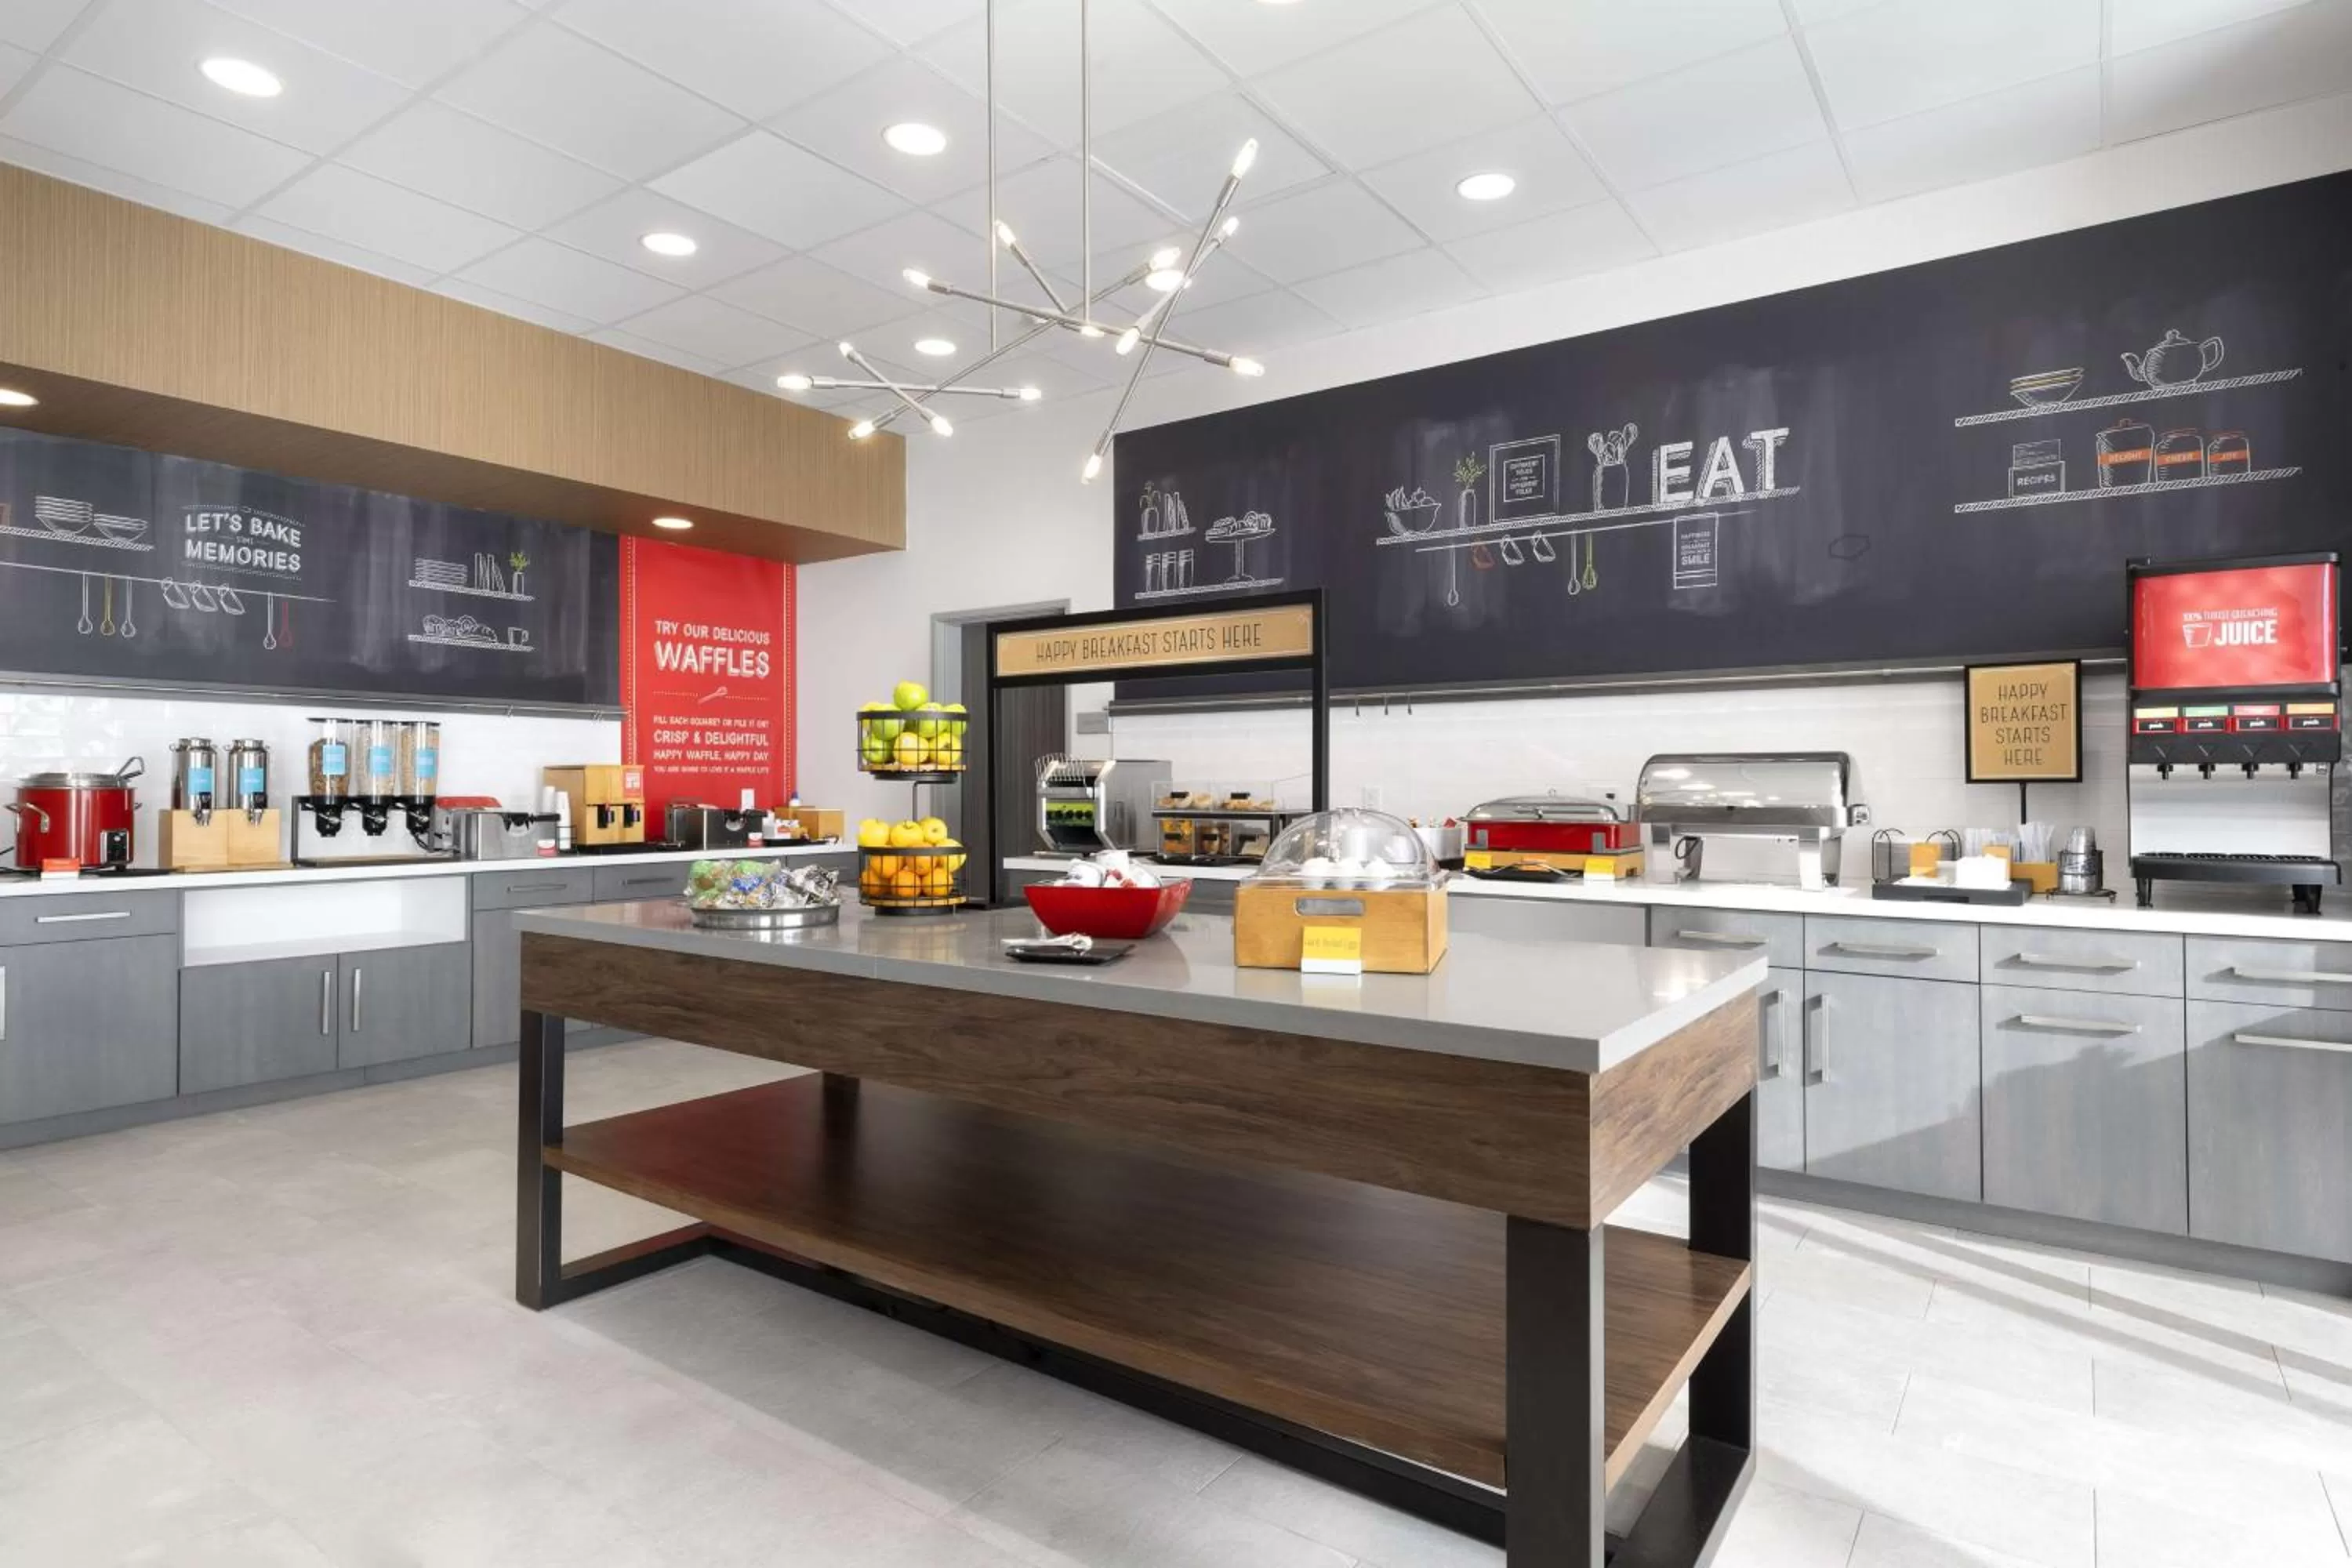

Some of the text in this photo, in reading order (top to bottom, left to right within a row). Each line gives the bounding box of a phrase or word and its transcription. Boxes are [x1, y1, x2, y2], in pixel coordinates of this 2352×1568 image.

[1652, 427, 1790, 506] EAT
[2108, 451, 2143, 463] DELIGHT
[2016, 473, 2056, 487] RECIPES
[185, 512, 301, 548] LET'S BAKE
[185, 539, 302, 572] MEMORIES
[1681, 553, 1711, 565] SMILE
[655, 620, 771, 645] TRY OUR DELICIOUS
[2214, 619, 2278, 647] JUICE
[1036, 623, 1262, 663] HAPPY BREAKFAST STARTS HERE
[654, 641, 770, 679] WAFFLES
[1998, 682, 2048, 701] HAPPY
[1981, 703, 2067, 724] BREAKFAST
[653, 729, 769, 746] CRISP & DELIGHTFUL
[1995, 725, 2050, 744] STARTS
[653, 750, 683, 760] HAPPY
[724, 750, 750, 761] HAPPY
[753, 751, 769, 762] DAY
[2005, 747, 2043, 766] HERE
